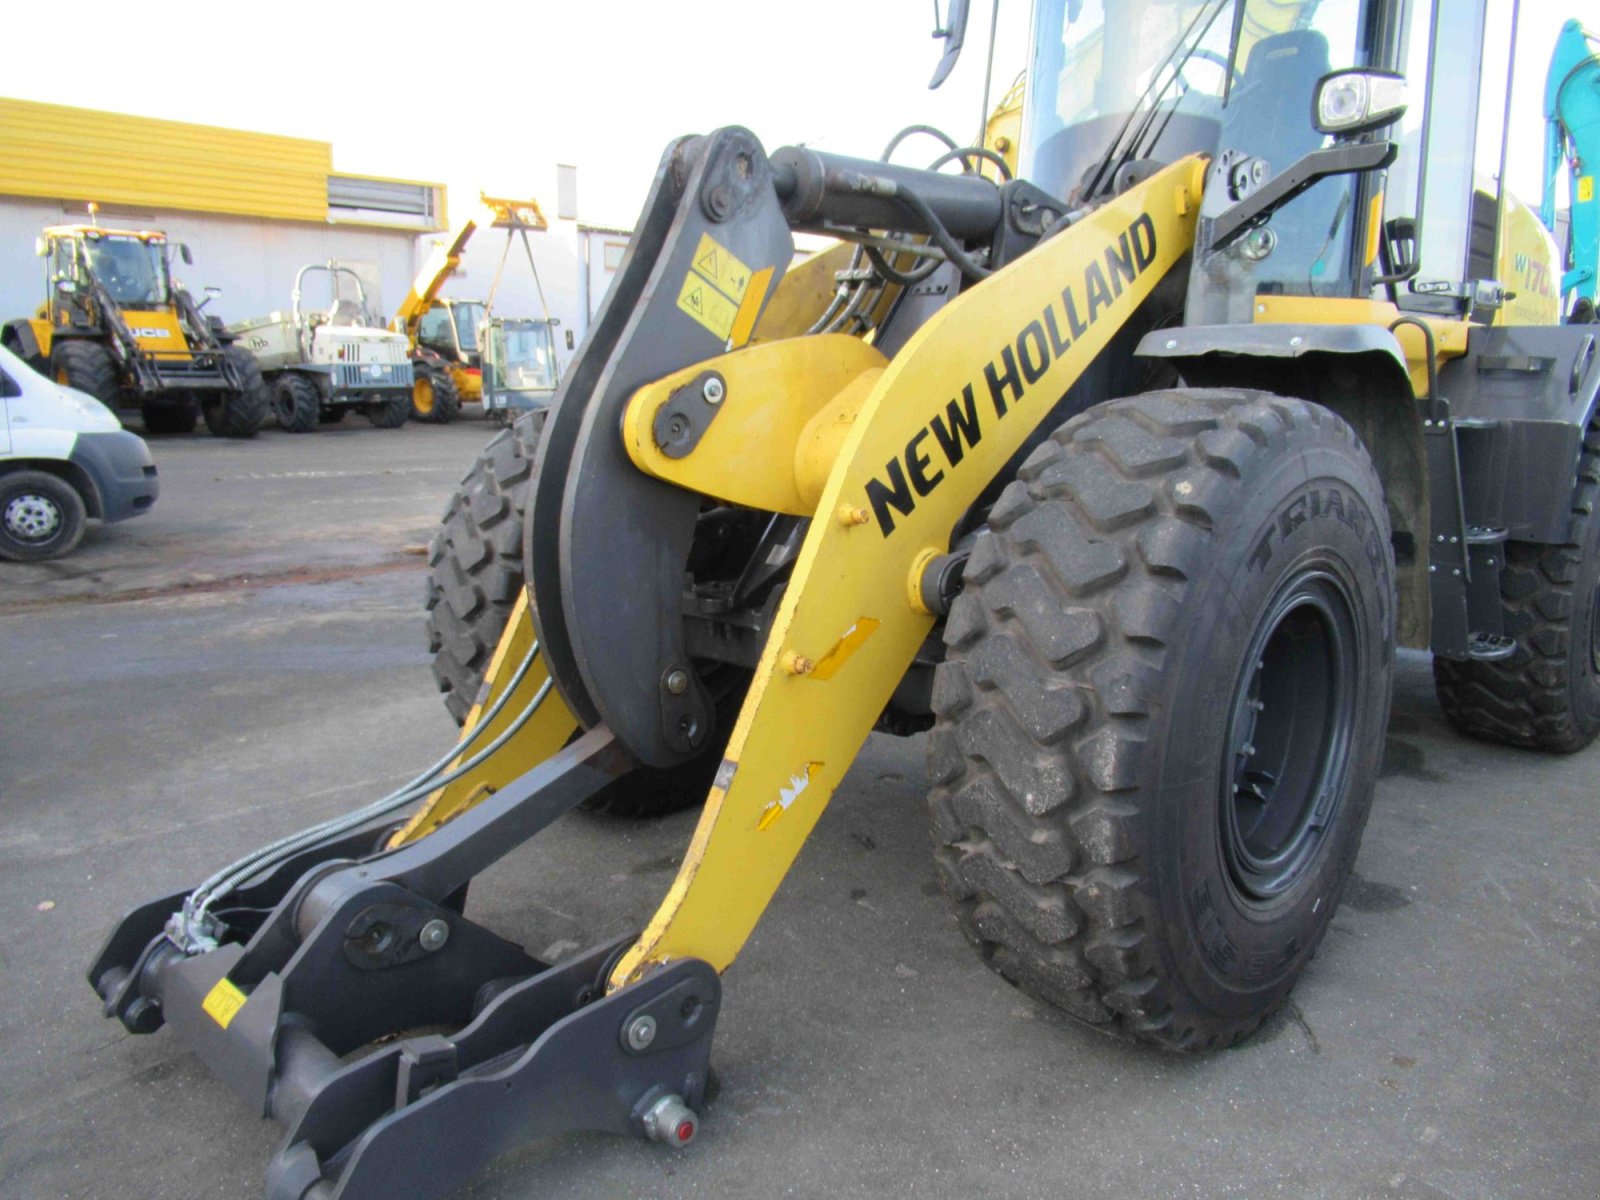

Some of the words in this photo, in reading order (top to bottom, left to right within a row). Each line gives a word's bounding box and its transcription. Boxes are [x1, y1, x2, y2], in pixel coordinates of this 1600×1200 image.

[130, 327, 171, 338] JCB
[864, 382, 982, 539] NEW
[983, 212, 1157, 421] HOLLAND
